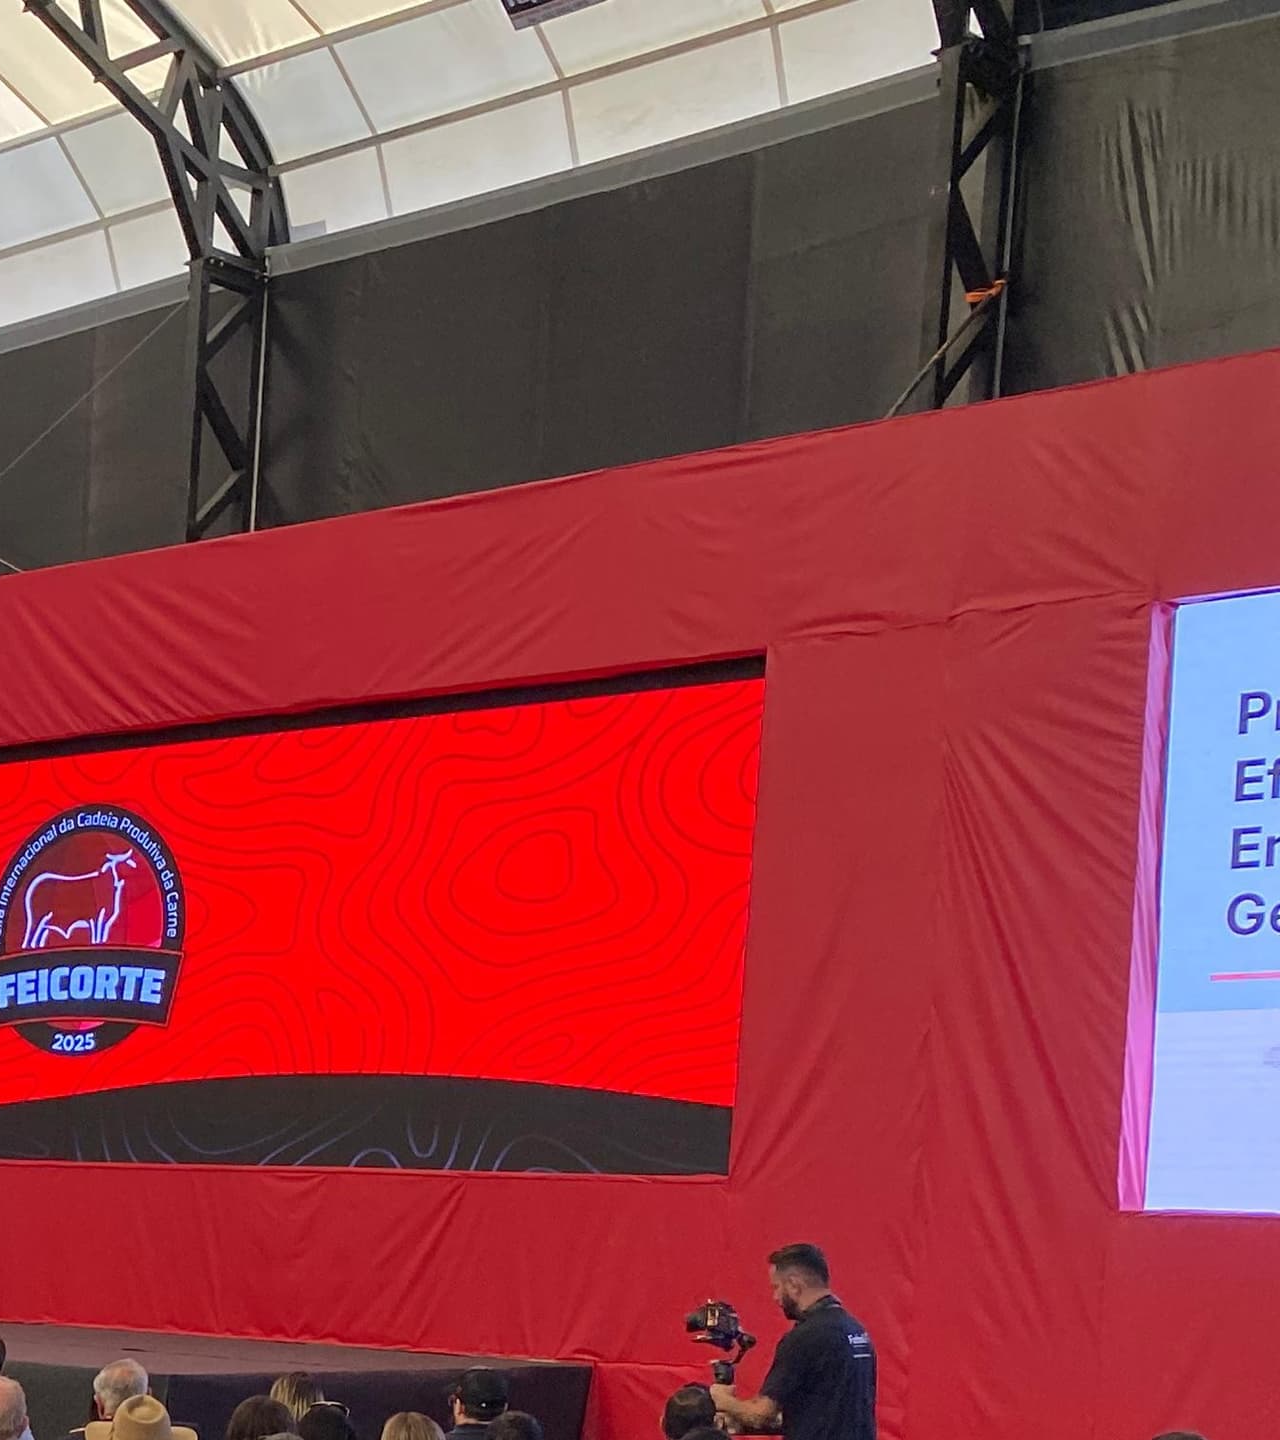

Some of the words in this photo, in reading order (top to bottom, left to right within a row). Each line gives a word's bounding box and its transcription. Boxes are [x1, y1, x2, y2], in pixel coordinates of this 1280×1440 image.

[59, 817, 75, 834] da
[77, 811, 119, 828] Cadeia
[120, 817, 166, 869] Produtiva
[161, 868, 175, 889] da
[166, 891, 179, 938] Carne
[52, 1033, 95, 1051] 2025
